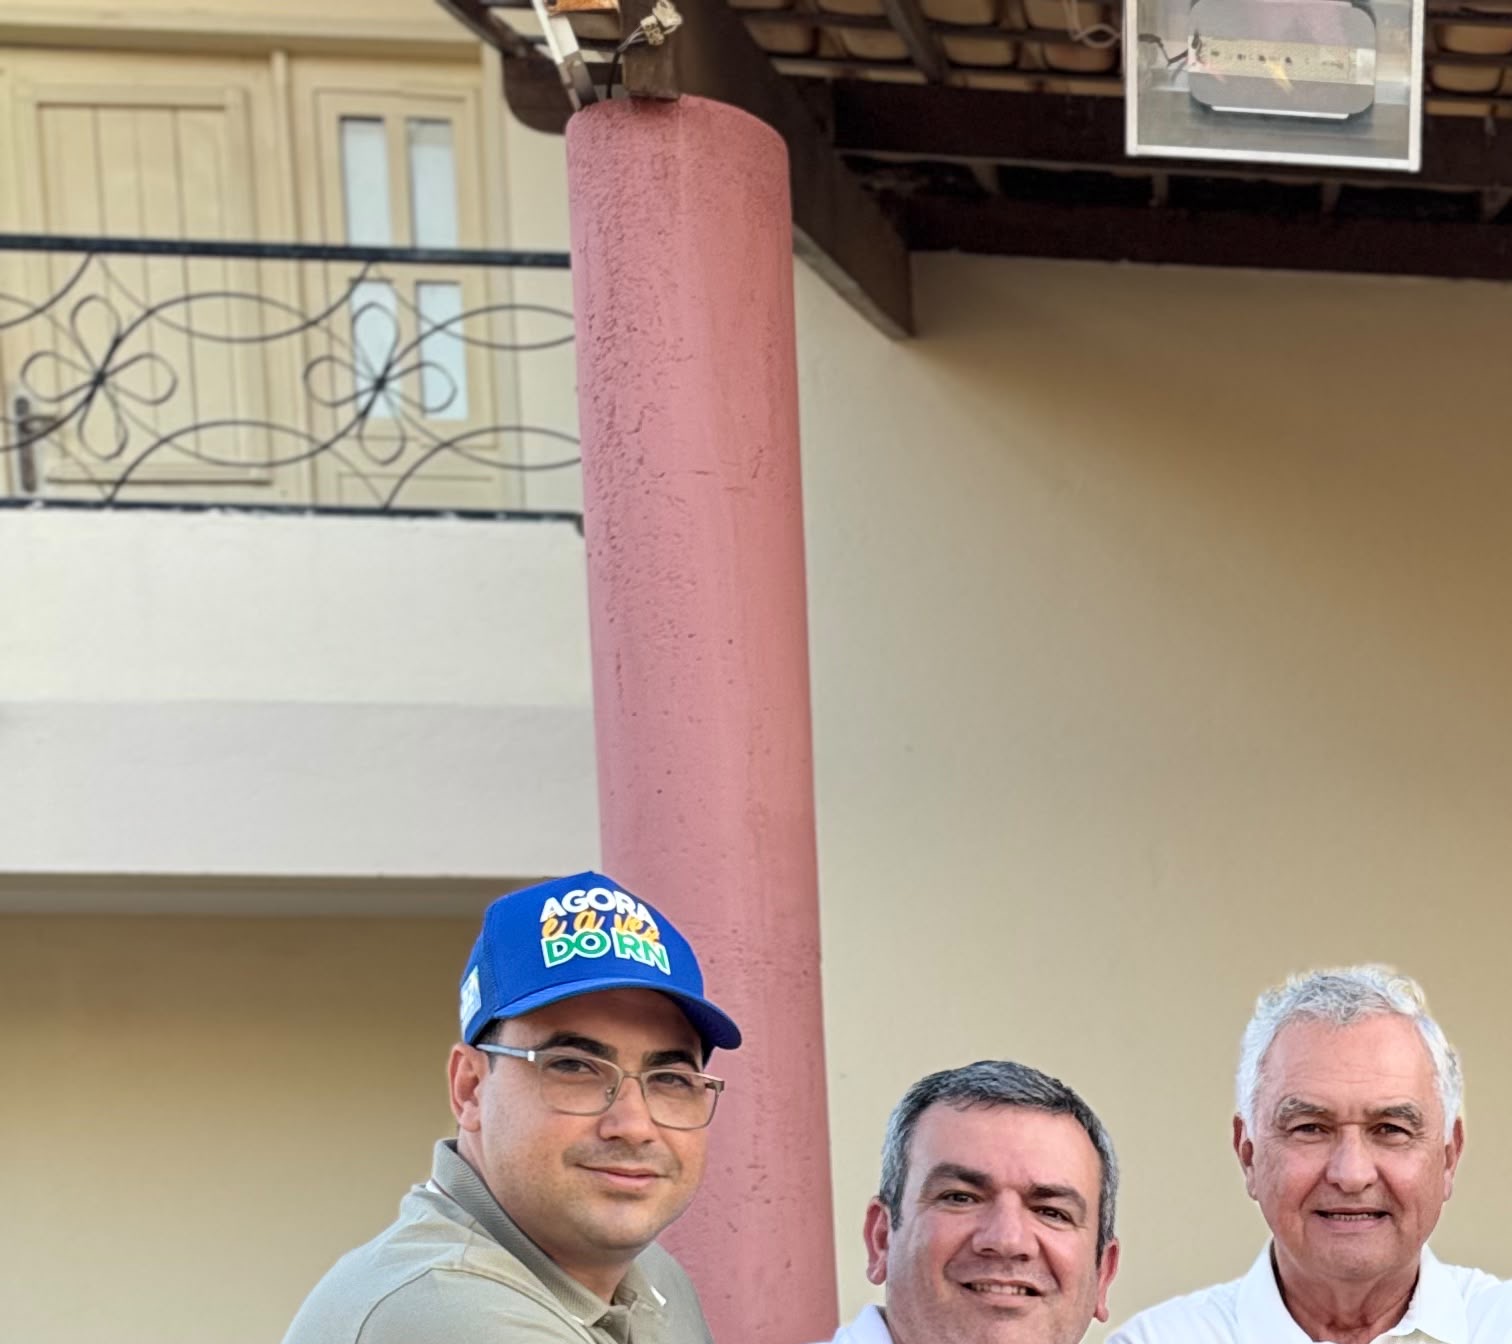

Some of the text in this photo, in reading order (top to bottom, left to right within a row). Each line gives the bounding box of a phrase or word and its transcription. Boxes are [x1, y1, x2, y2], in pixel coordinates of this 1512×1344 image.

[540, 887, 659, 930] AGORA
[541, 927, 671, 975] DO RN
